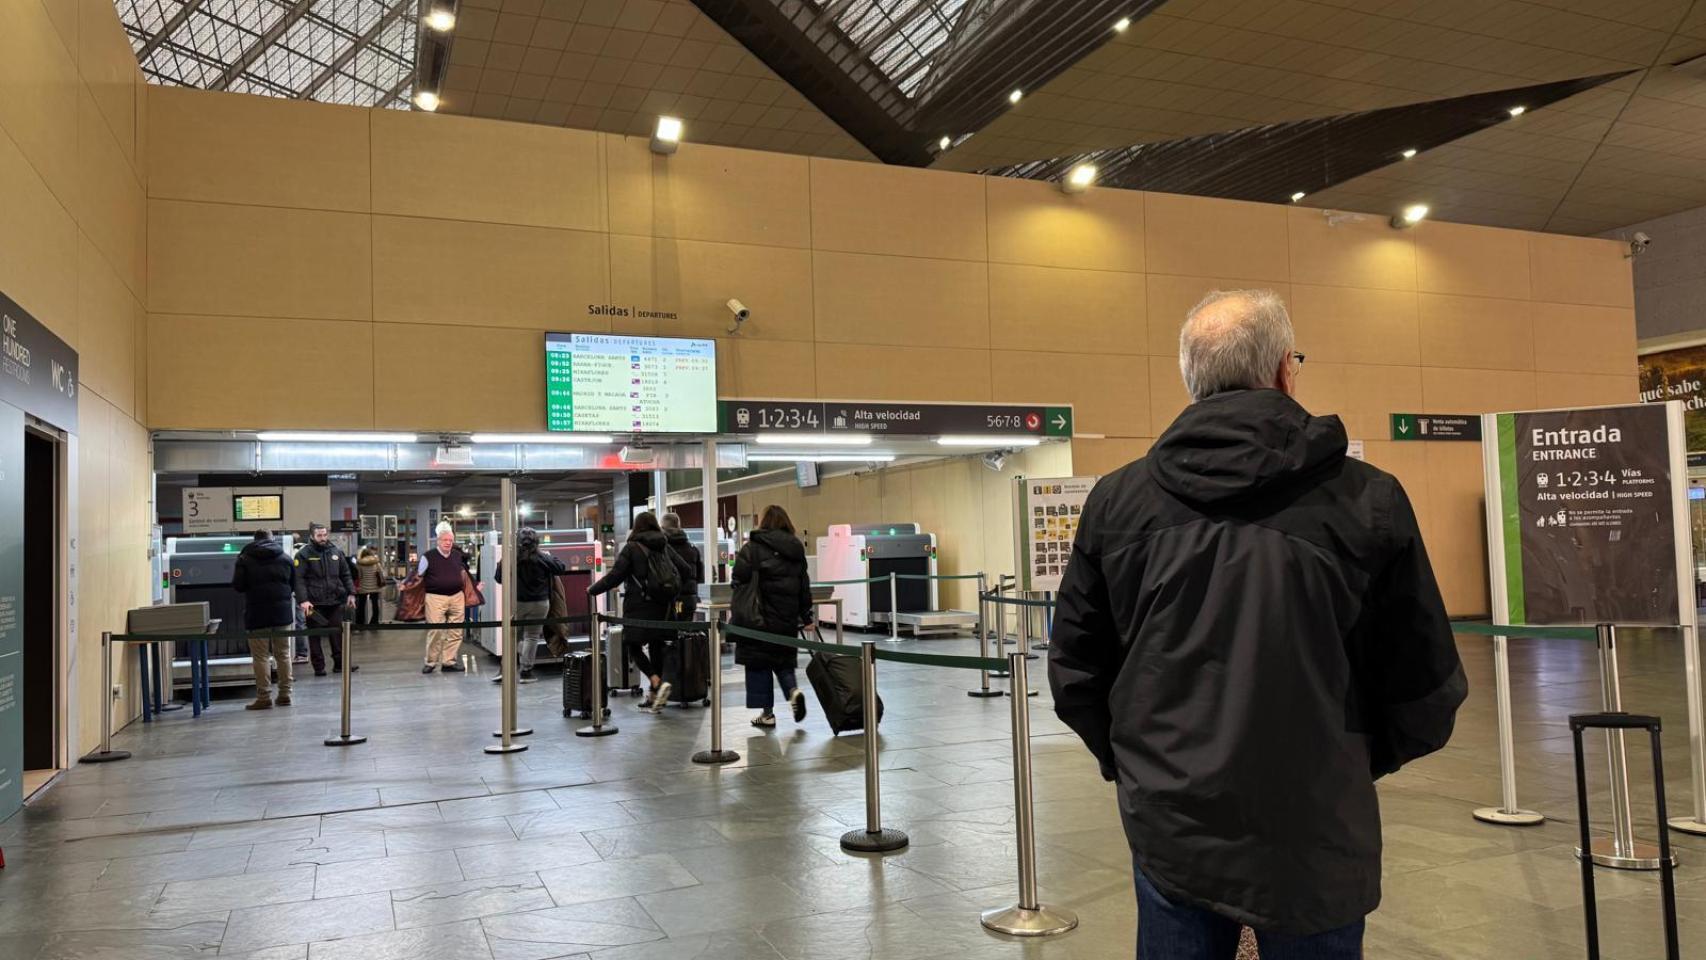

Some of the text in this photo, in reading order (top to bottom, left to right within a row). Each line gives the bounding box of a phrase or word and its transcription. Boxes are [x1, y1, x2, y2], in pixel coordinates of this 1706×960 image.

[588, 304, 678, 320] Salidas DEPARTURES
[3, 314, 17, 338] ONE
[575, 335, 609, 344] Salidas
[3, 333, 31, 367] HUNDRED
[51, 359, 64, 393] WC
[1639, 379, 1702, 404] qué sabe
[854, 410, 921, 421] Alta velocidad
[854, 422, 888, 431] HIGH SPEED
[1532, 424, 1622, 447] Entrada
[1532, 448, 1597, 461] ENTRANCE
[1621, 468, 1642, 477] Vías
[1537, 492, 1557, 501] Alta
[1559, 490, 1609, 501] velocidad
[188, 500, 199, 517] 3
